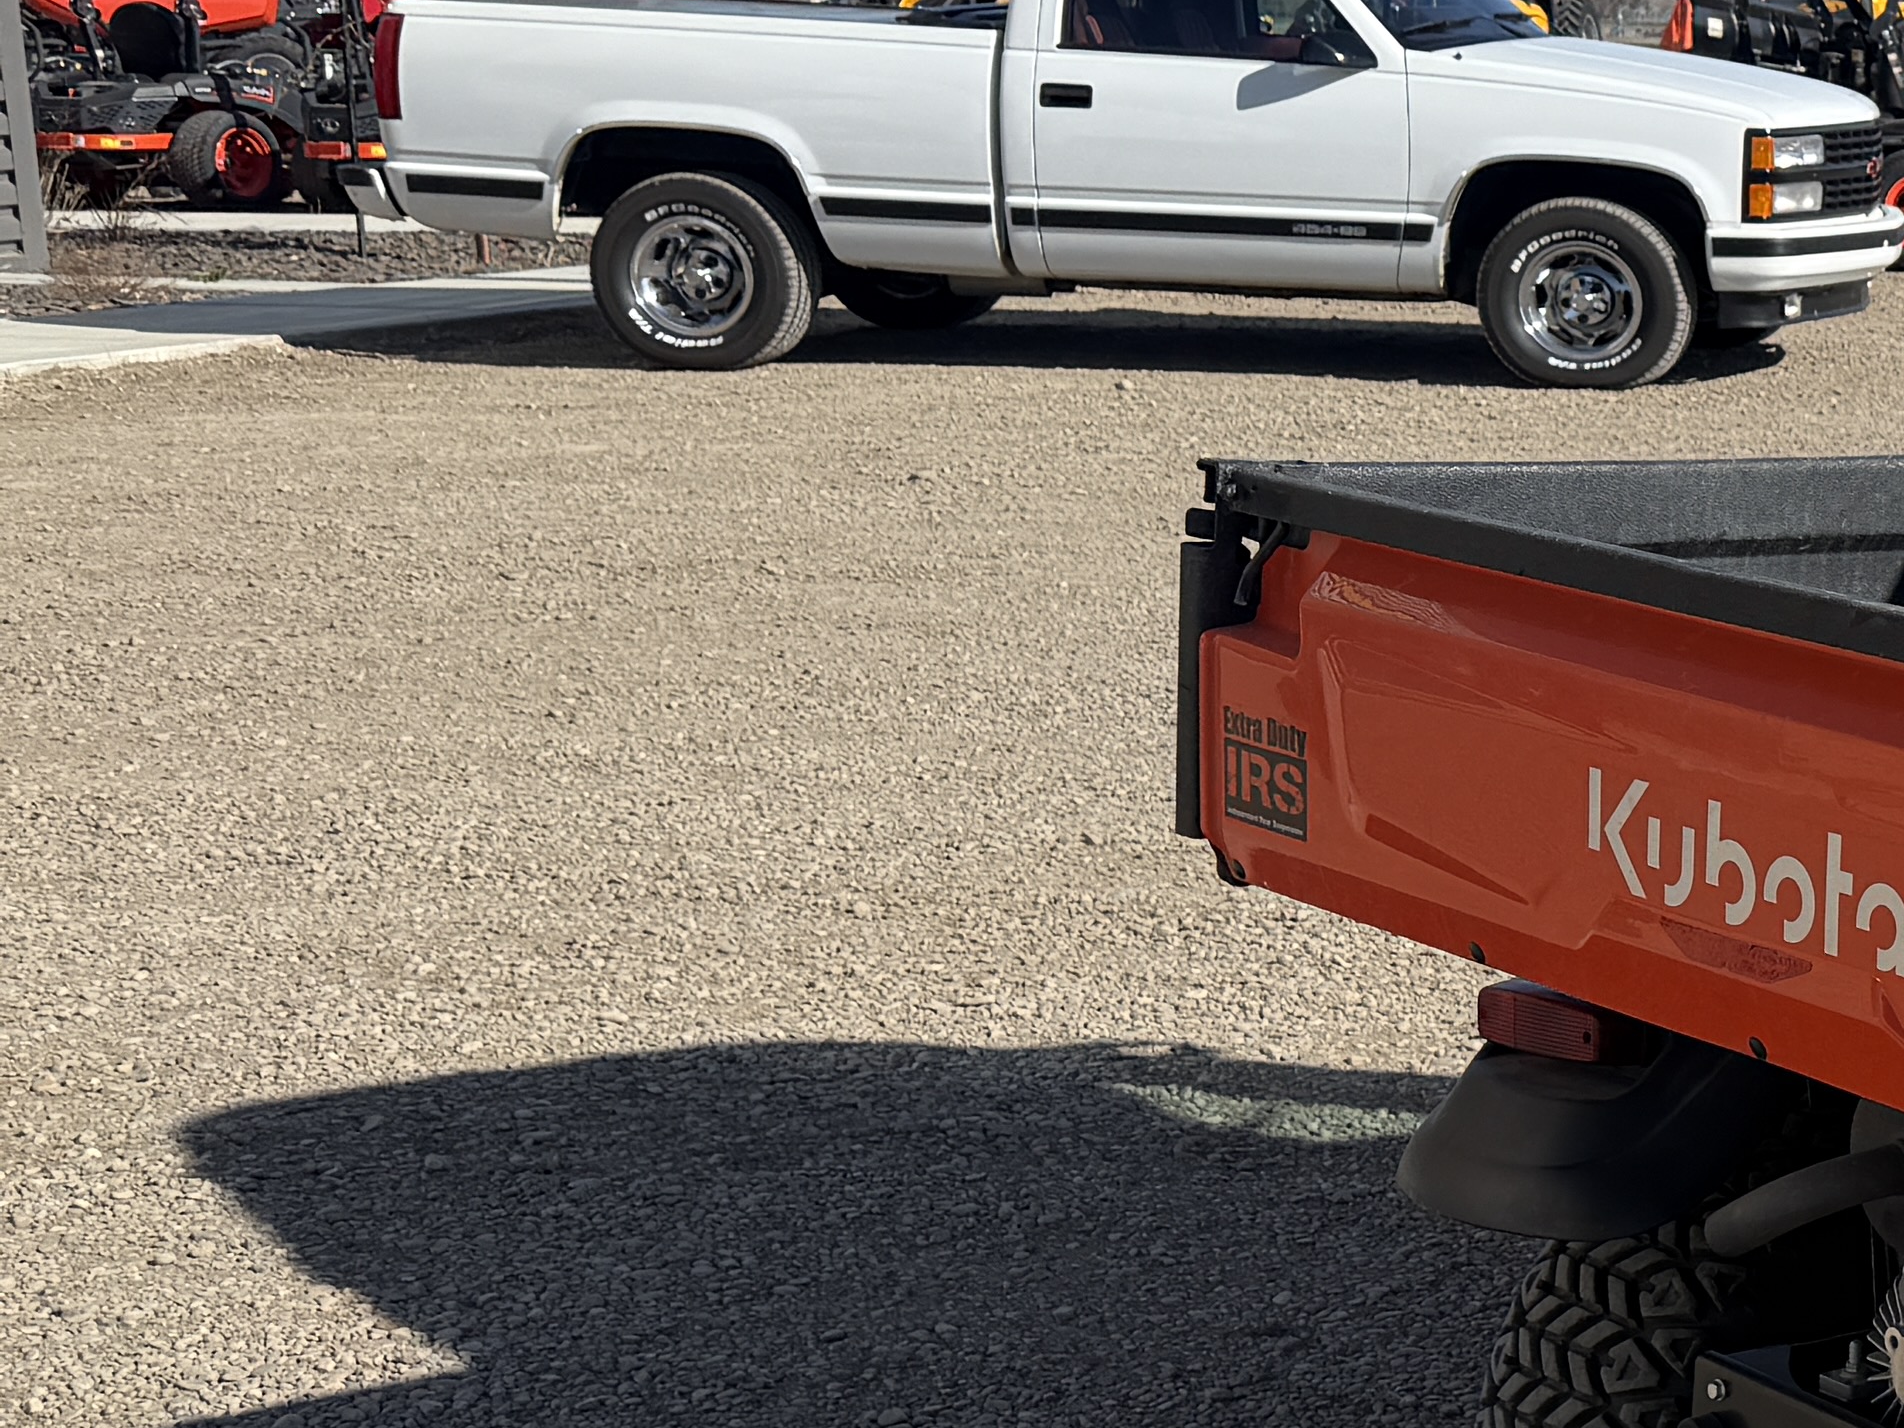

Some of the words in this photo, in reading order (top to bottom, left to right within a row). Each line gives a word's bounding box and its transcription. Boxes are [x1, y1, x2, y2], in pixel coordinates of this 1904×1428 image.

[1223, 705, 1263, 744] Extra
[1266, 717, 1307, 758] Duty
[1227, 745, 1304, 816] IRS
